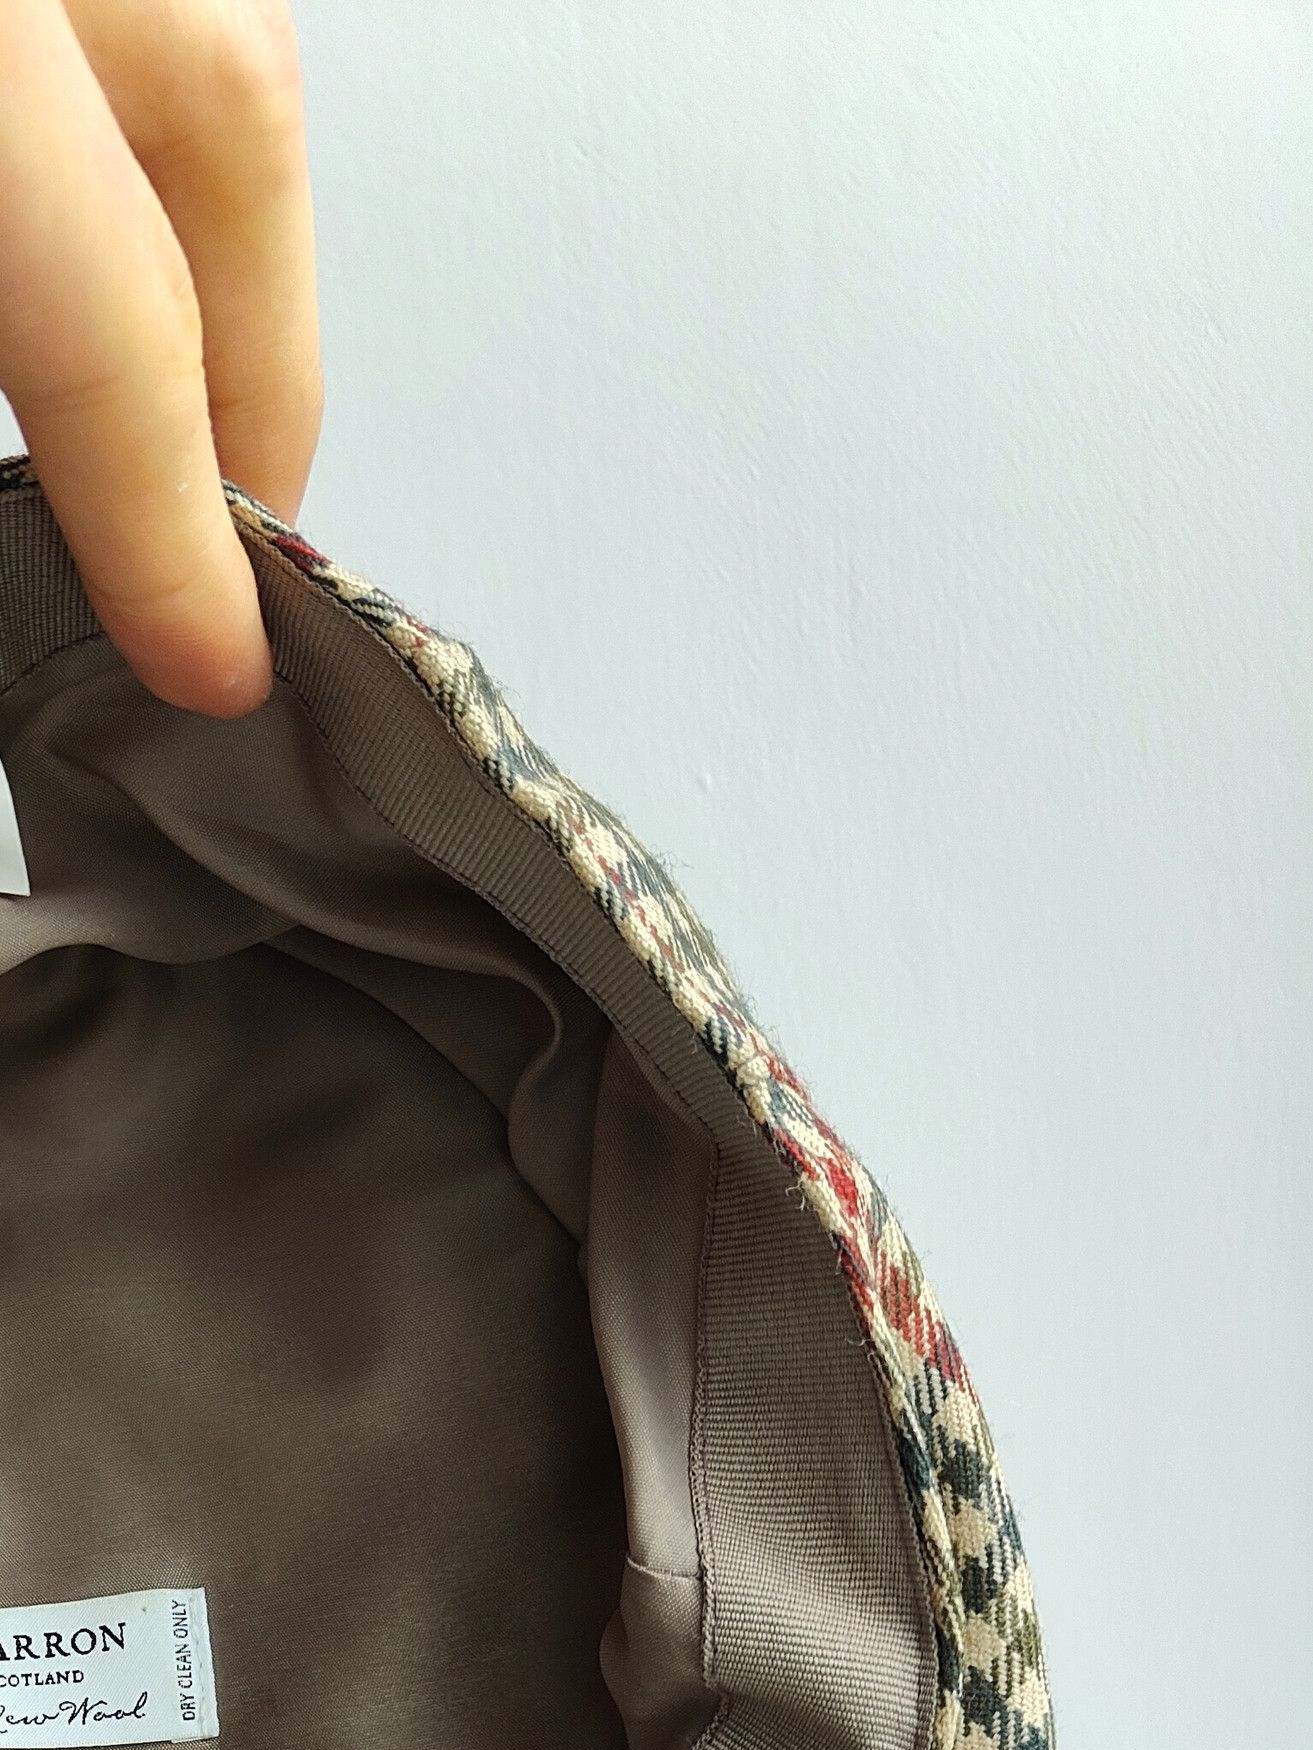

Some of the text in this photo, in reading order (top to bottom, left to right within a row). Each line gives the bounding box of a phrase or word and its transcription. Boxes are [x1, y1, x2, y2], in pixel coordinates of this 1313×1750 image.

[172, 1600, 196, 1721] DRY CLEAN ONLY
[59, 1691, 148, 1725] Wool
